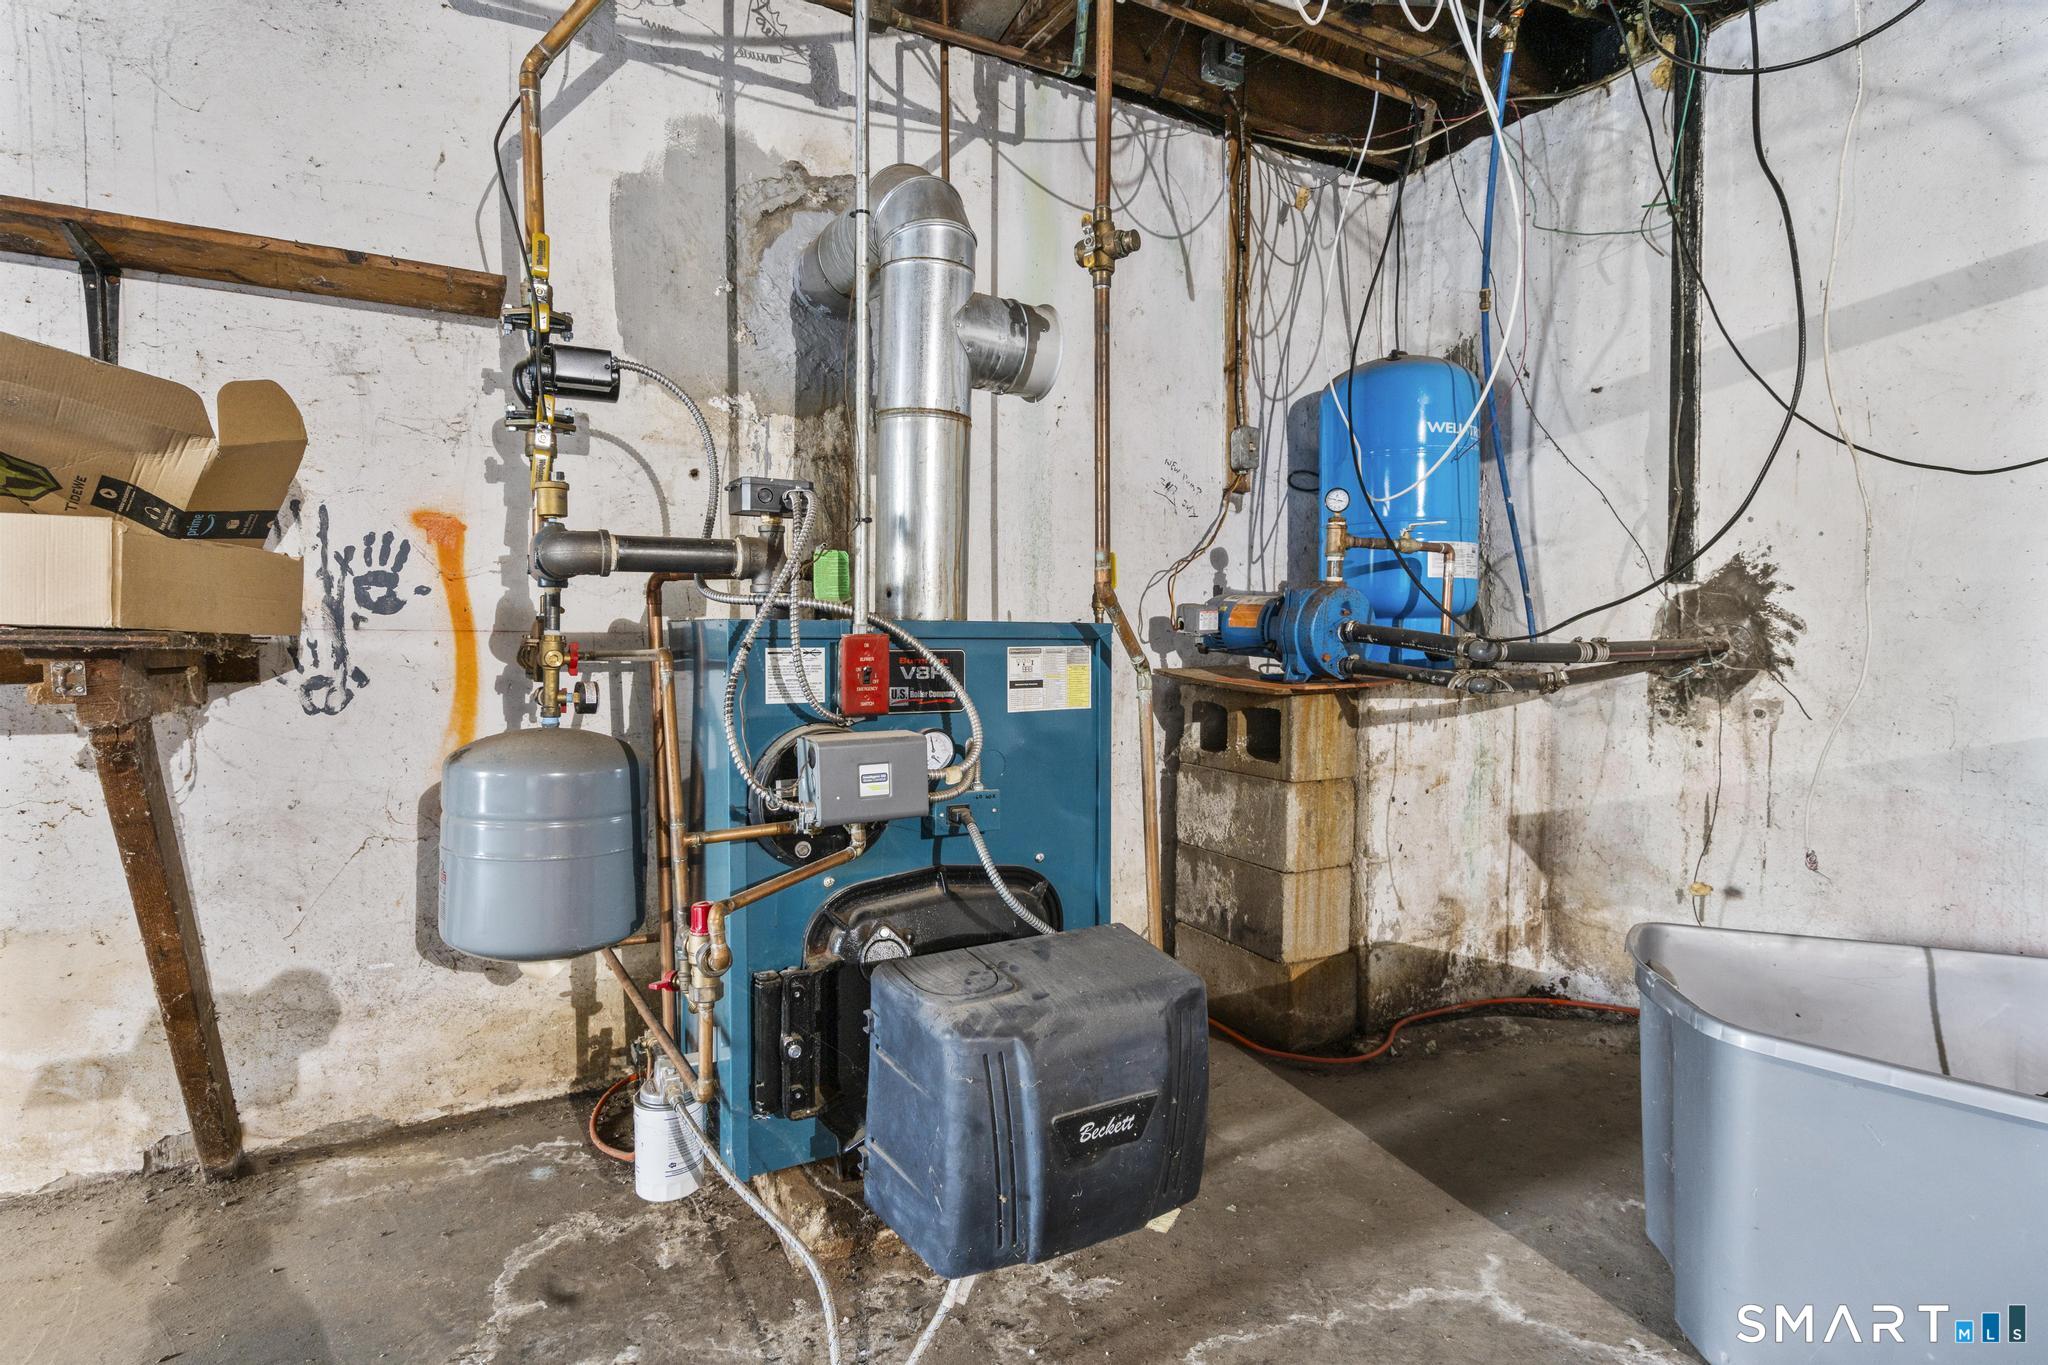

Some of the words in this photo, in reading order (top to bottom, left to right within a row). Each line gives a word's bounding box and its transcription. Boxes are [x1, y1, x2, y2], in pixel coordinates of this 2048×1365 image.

[187, 513, 204, 536] prime
[891, 688, 908, 700] U.S.
[928, 690, 956, 698] Company
[1080, 1114, 1136, 1143] Beckett
